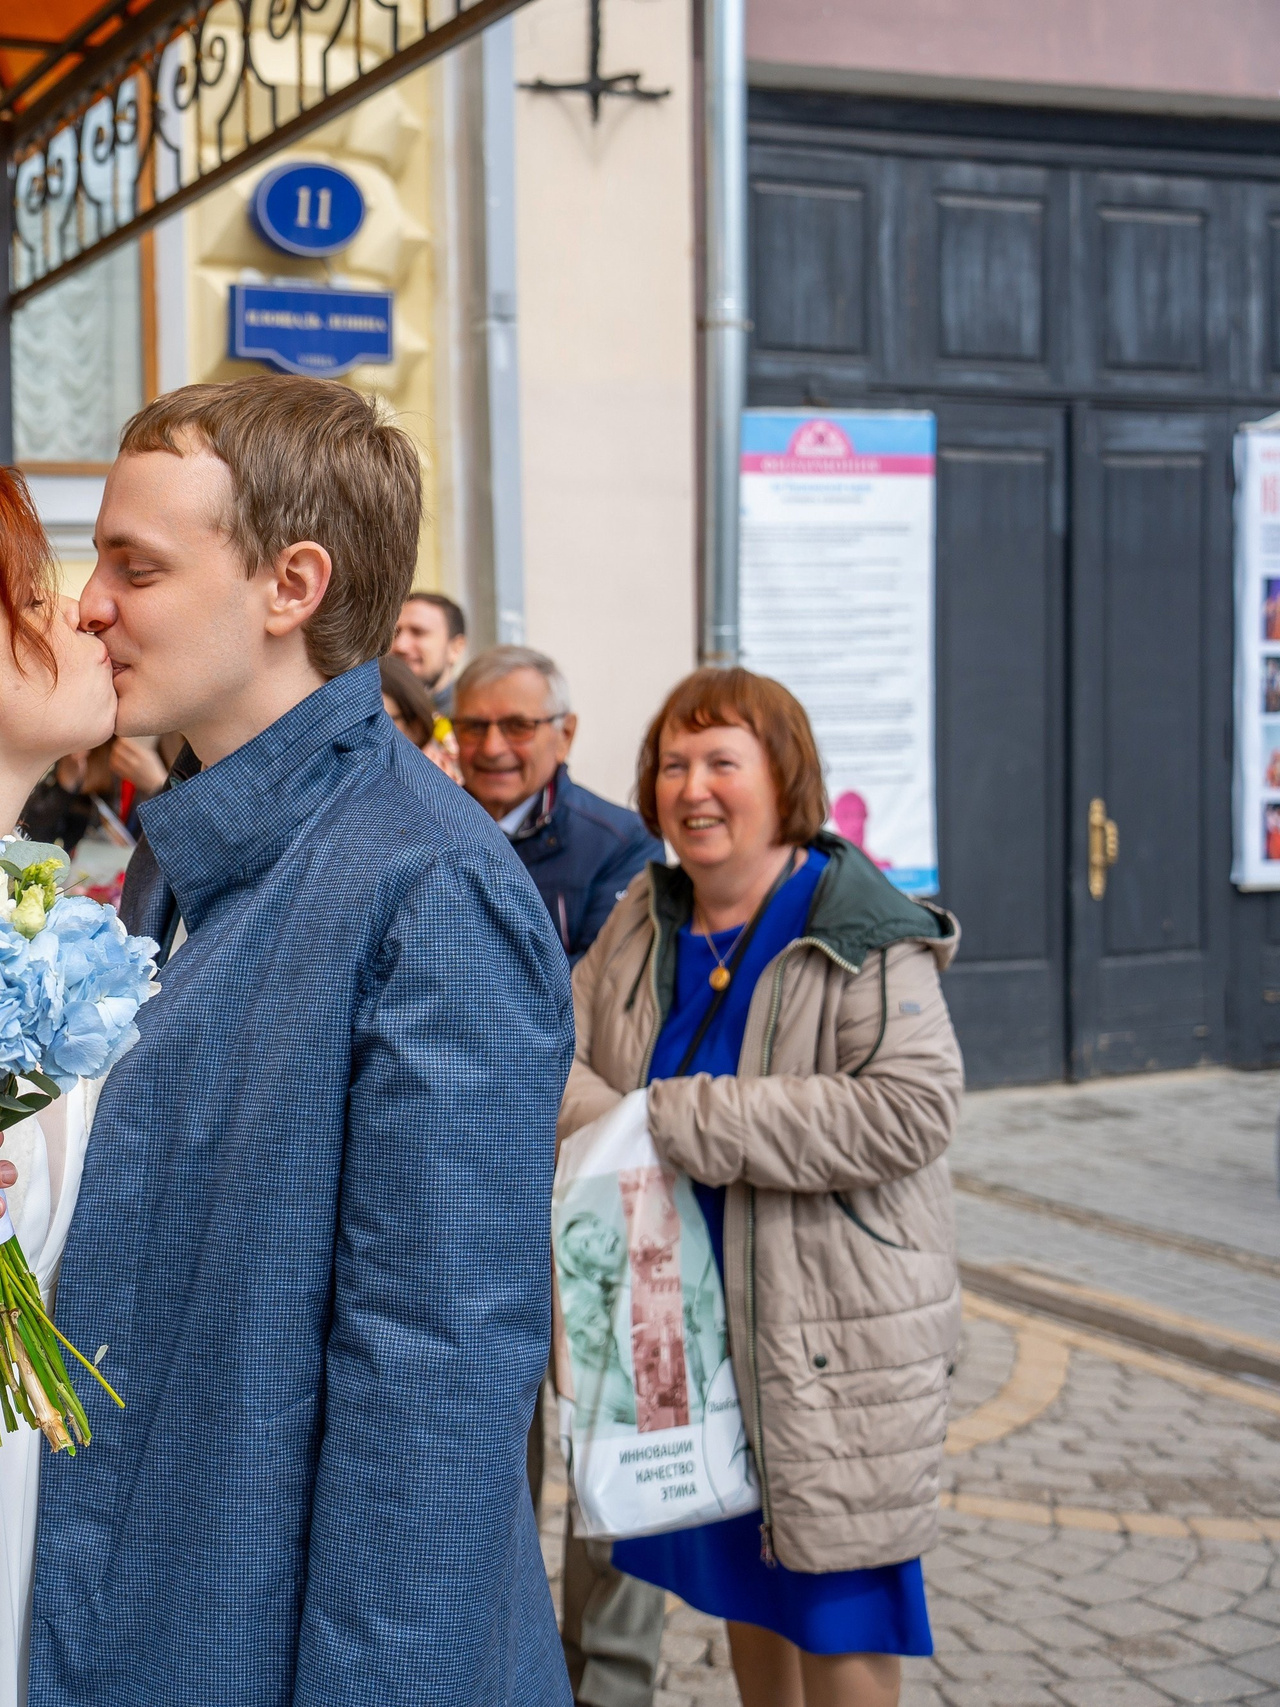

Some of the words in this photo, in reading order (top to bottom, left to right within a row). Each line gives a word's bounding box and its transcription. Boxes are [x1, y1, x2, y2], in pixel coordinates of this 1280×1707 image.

[295, 186, 332, 229] 11
[620, 1440, 693, 1465] ИННОВАЦИИ
[636, 1460, 694, 1484] КАЧЕСТВО
[661, 1482, 696, 1501] ЭТИКА
